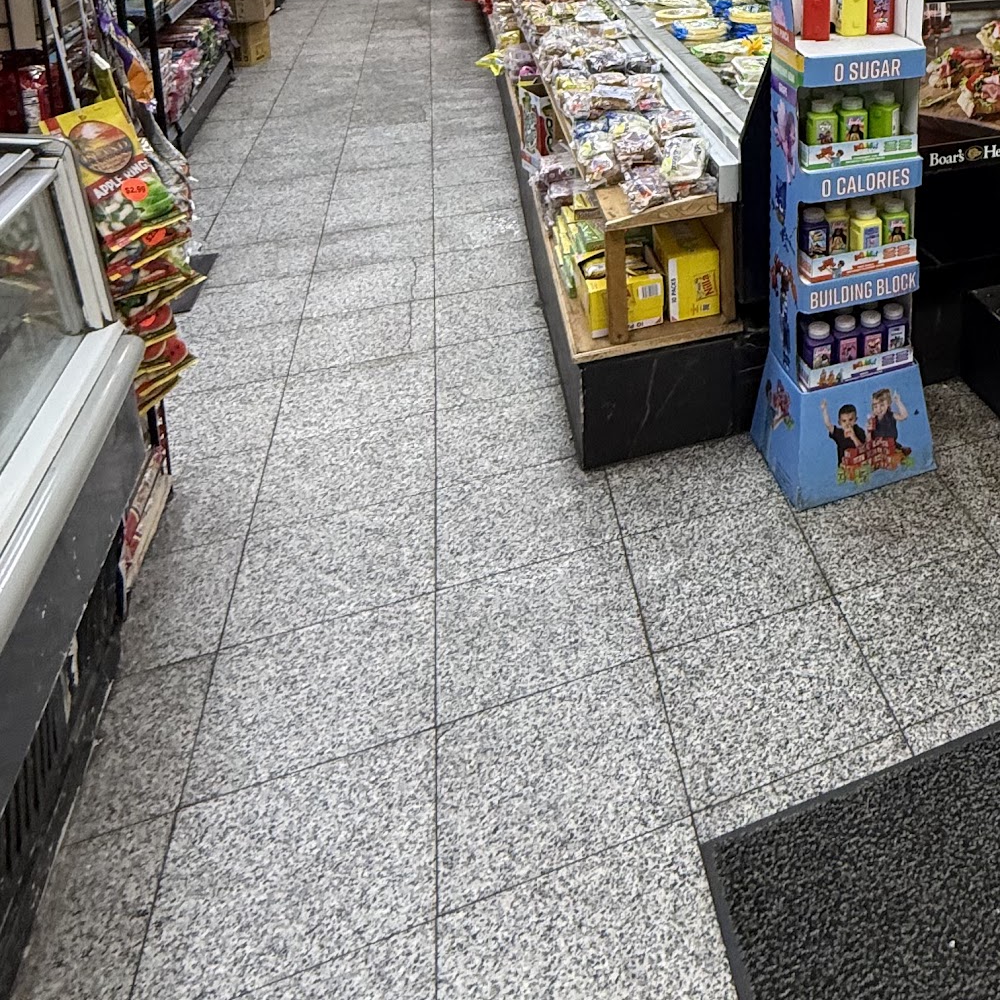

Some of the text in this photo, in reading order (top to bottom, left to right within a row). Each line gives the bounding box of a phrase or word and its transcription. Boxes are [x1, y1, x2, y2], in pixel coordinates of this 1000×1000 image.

[850, 59, 900, 80] SUGAR
[929, 150, 965, 167] Boar's
[93, 176, 123, 199] APPLE
[125, 185, 145, 194] $2.99
[836, 168, 910, 195] CALORIES
[702, 275, 714, 296] Nilla
[810, 272, 916, 309] BUILDING BLOCK
